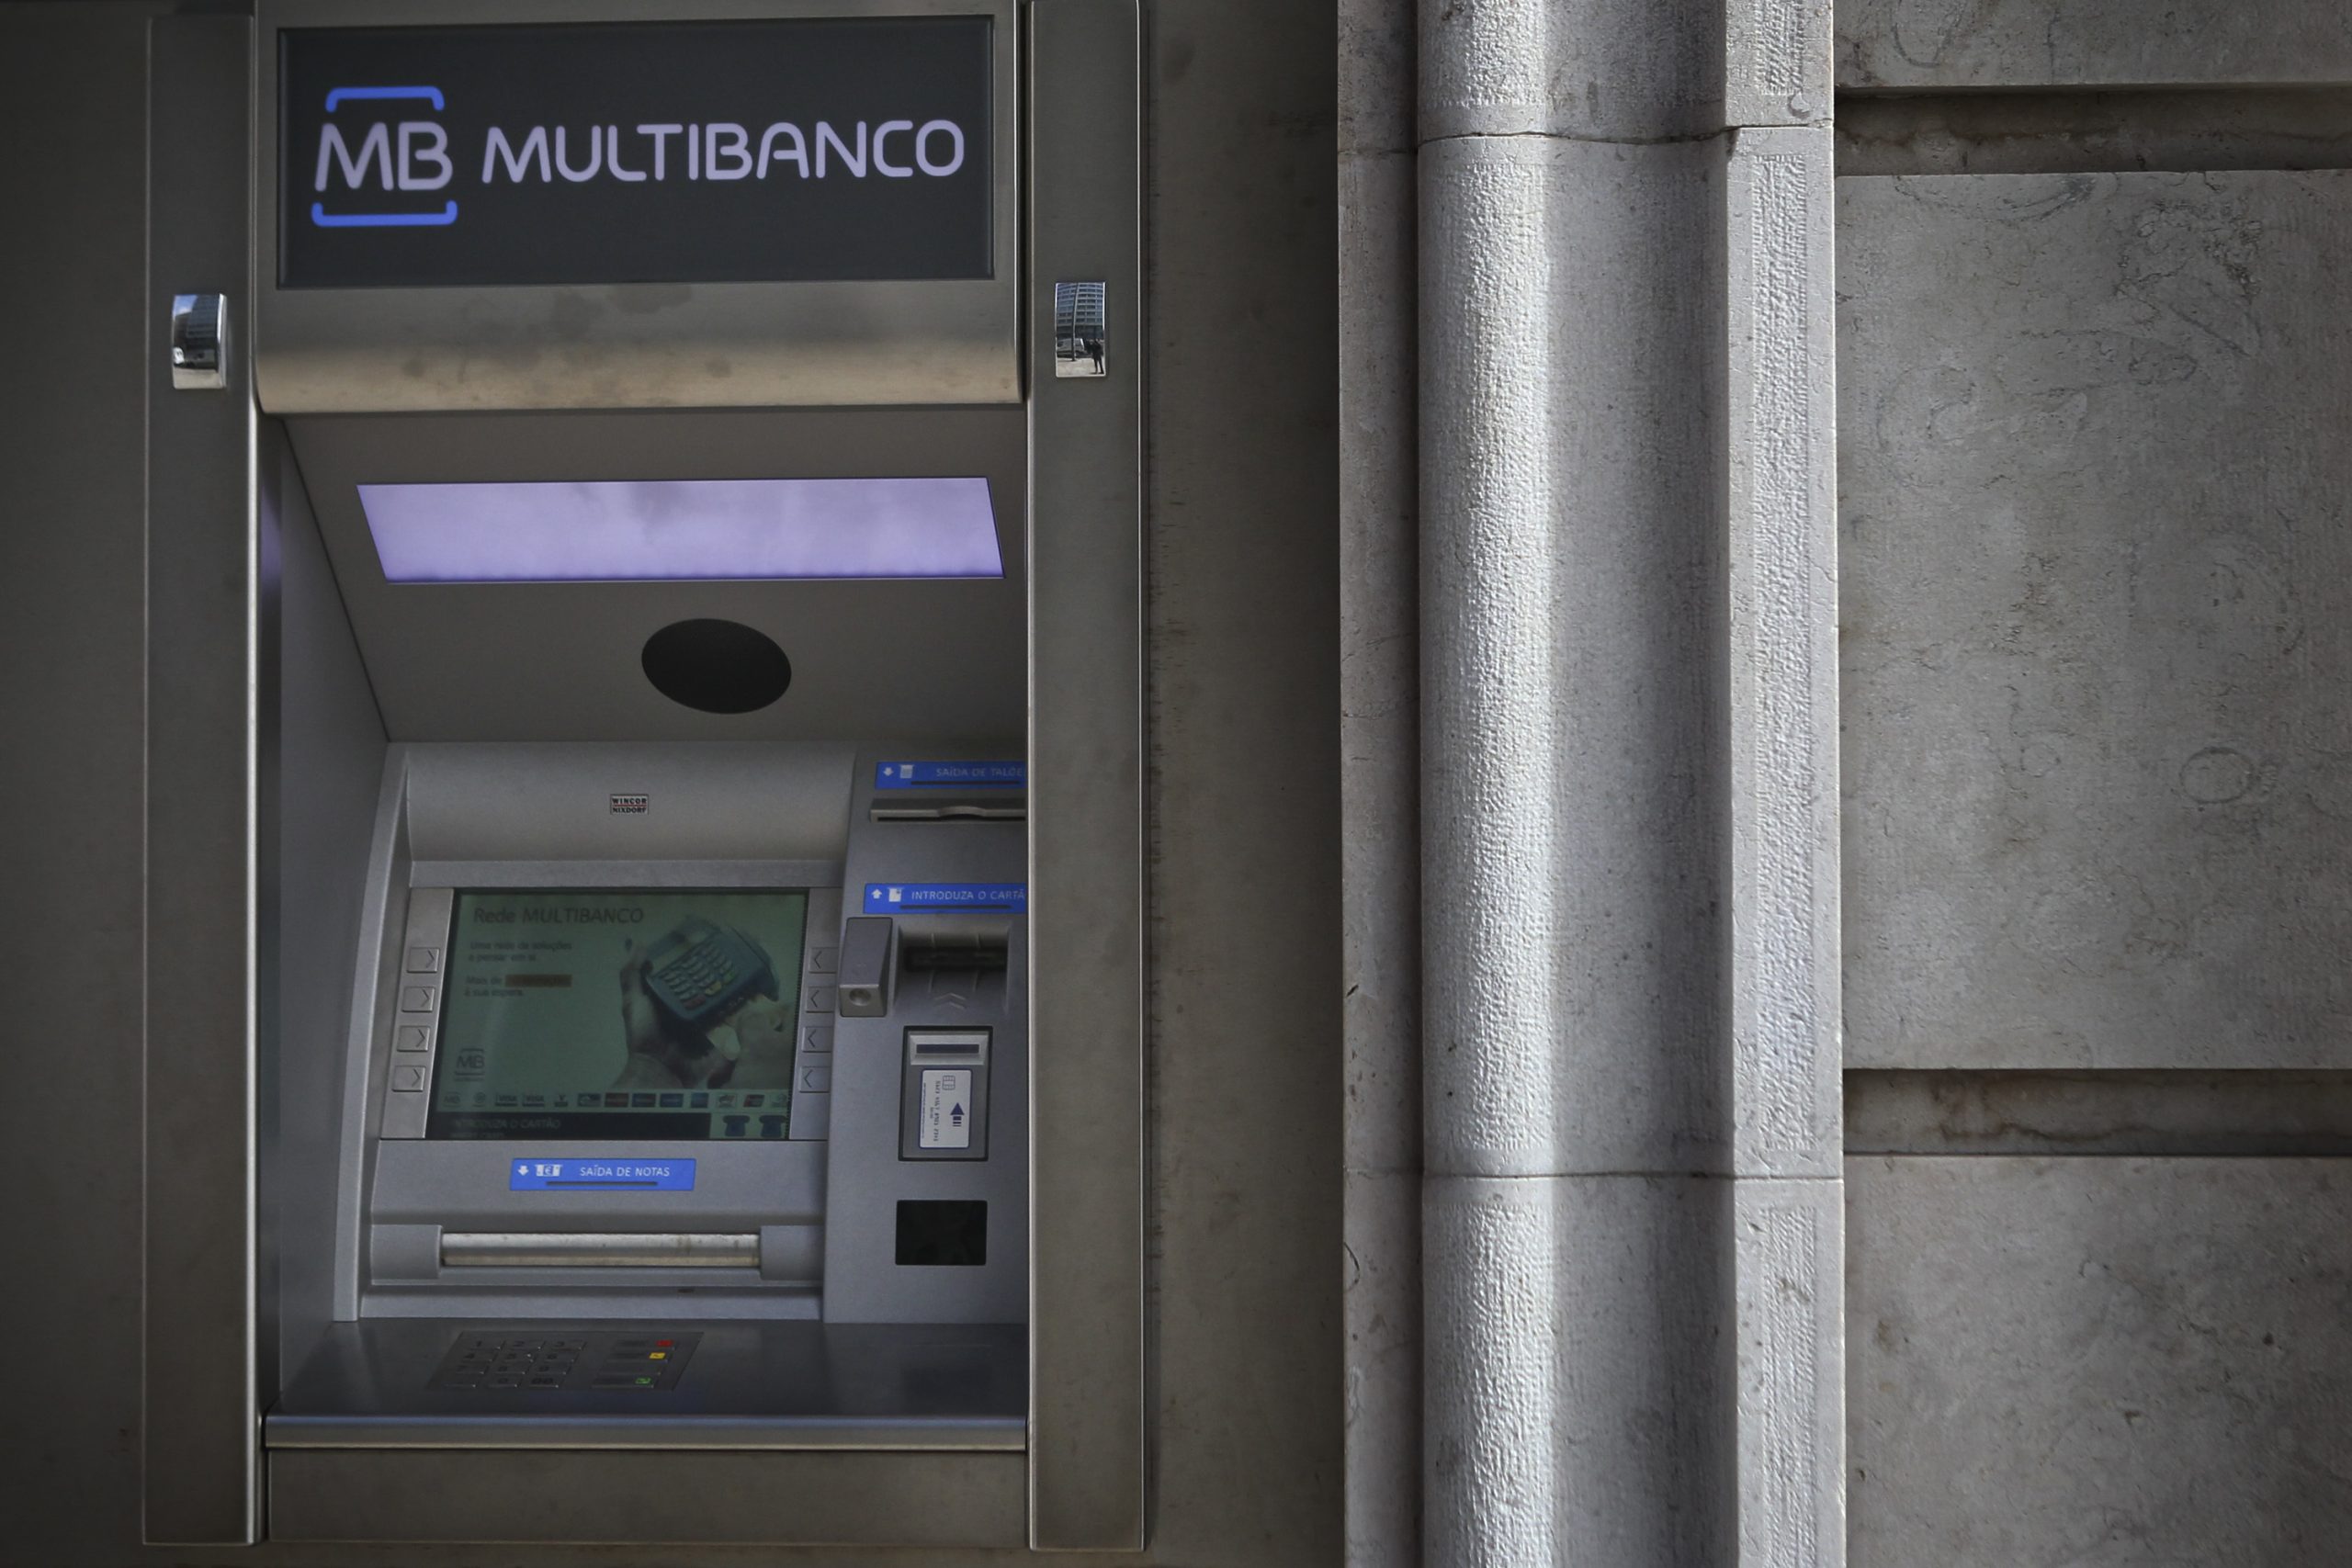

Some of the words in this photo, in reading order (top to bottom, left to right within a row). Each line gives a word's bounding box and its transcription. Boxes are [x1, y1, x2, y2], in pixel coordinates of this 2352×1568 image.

[314, 121, 454, 192] MB
[481, 119, 965, 184] MULTIBANCO
[936, 766, 967, 777] SAÍDA
[971, 767, 986, 777] DE
[911, 890, 974, 900] INTRODUZA
[978, 890, 987, 900] O
[473, 907, 516, 923] Rede
[522, 907, 645, 924] MULTIBANCO
[456, 1055, 485, 1069] MB
[580, 1165, 613, 1177] SAÍDA
[616, 1167, 631, 1177] DE
[635, 1167, 670, 1177] NOTAS
